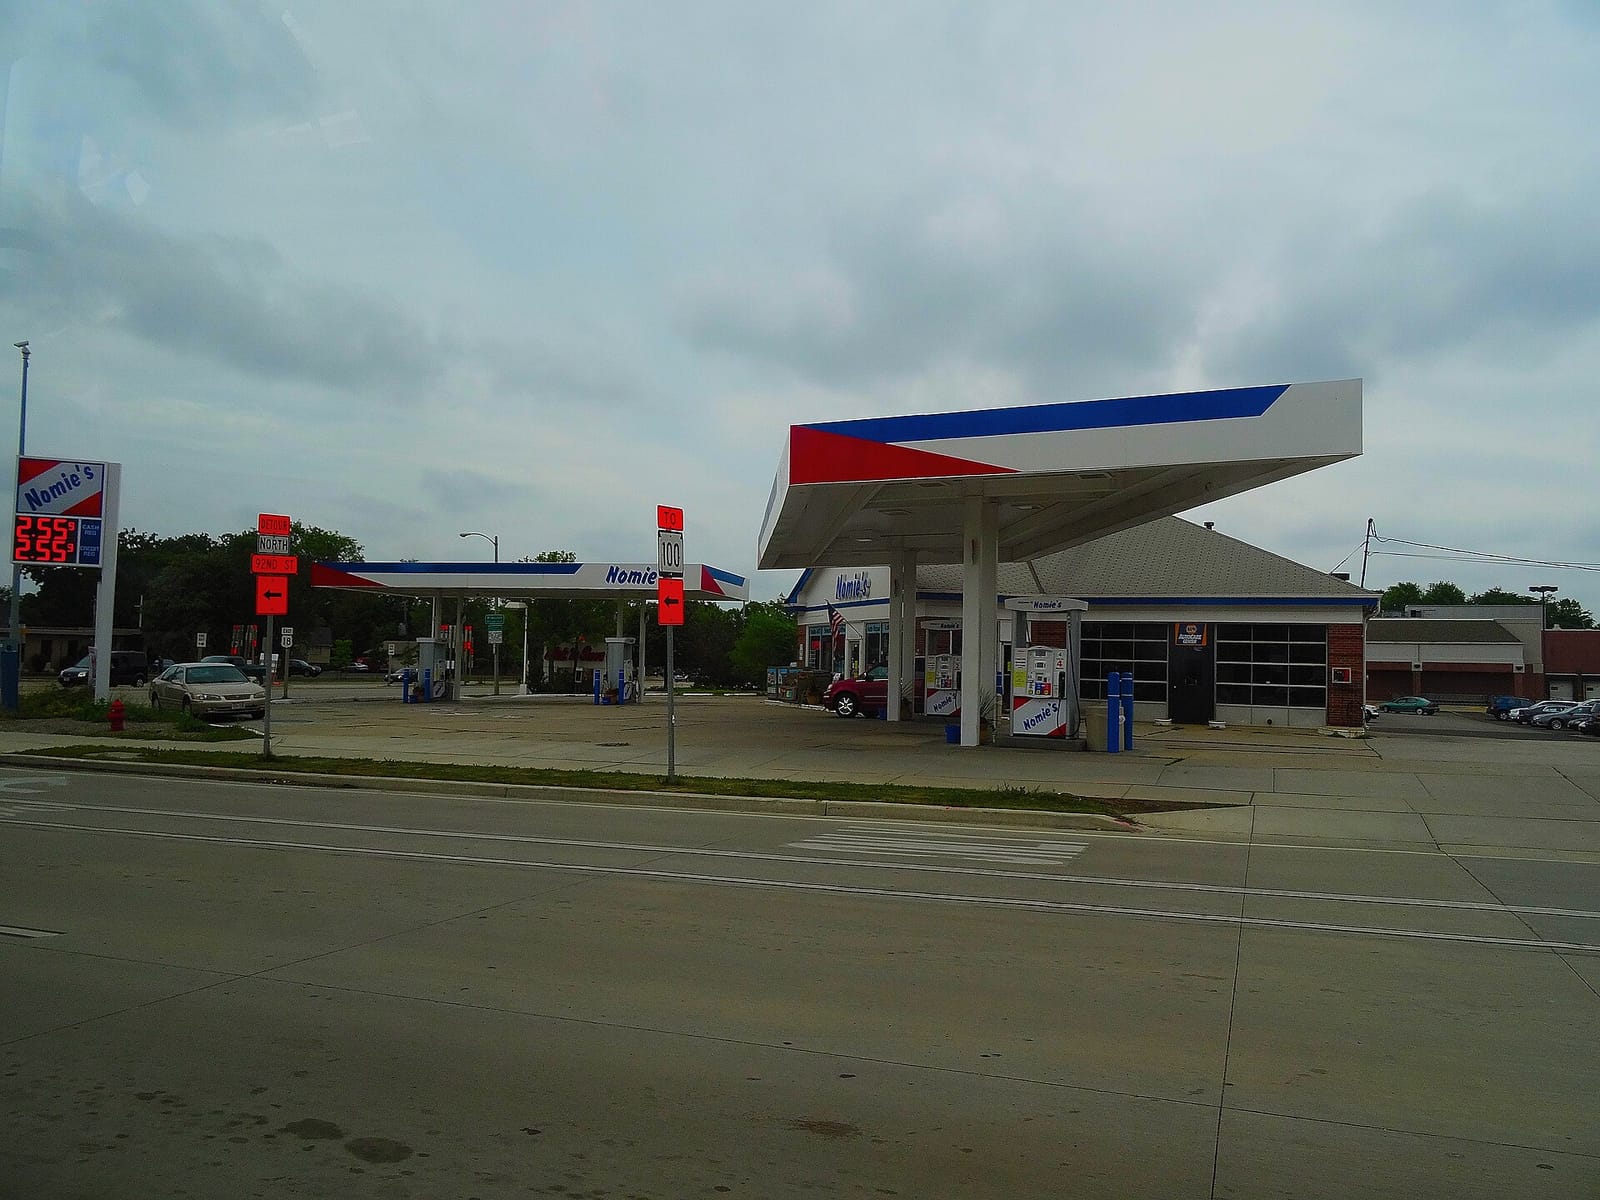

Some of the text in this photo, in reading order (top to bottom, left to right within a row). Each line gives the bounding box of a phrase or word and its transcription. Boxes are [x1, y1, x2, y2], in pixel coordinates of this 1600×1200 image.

[24, 465, 95, 511] Nomie's
[261, 519, 287, 530] DETOUR
[664, 511, 676, 525] TO
[260, 537, 288, 551] NORTH
[662, 542, 680, 568] 100
[256, 559, 294, 570] 92ND ST
[605, 565, 657, 585] Nomie
[835, 571, 871, 600] Nomie's
[1033, 600, 1062, 608] Nomie's
[283, 637, 291, 645] 18
[1023, 702, 1058, 731] Nomie's
